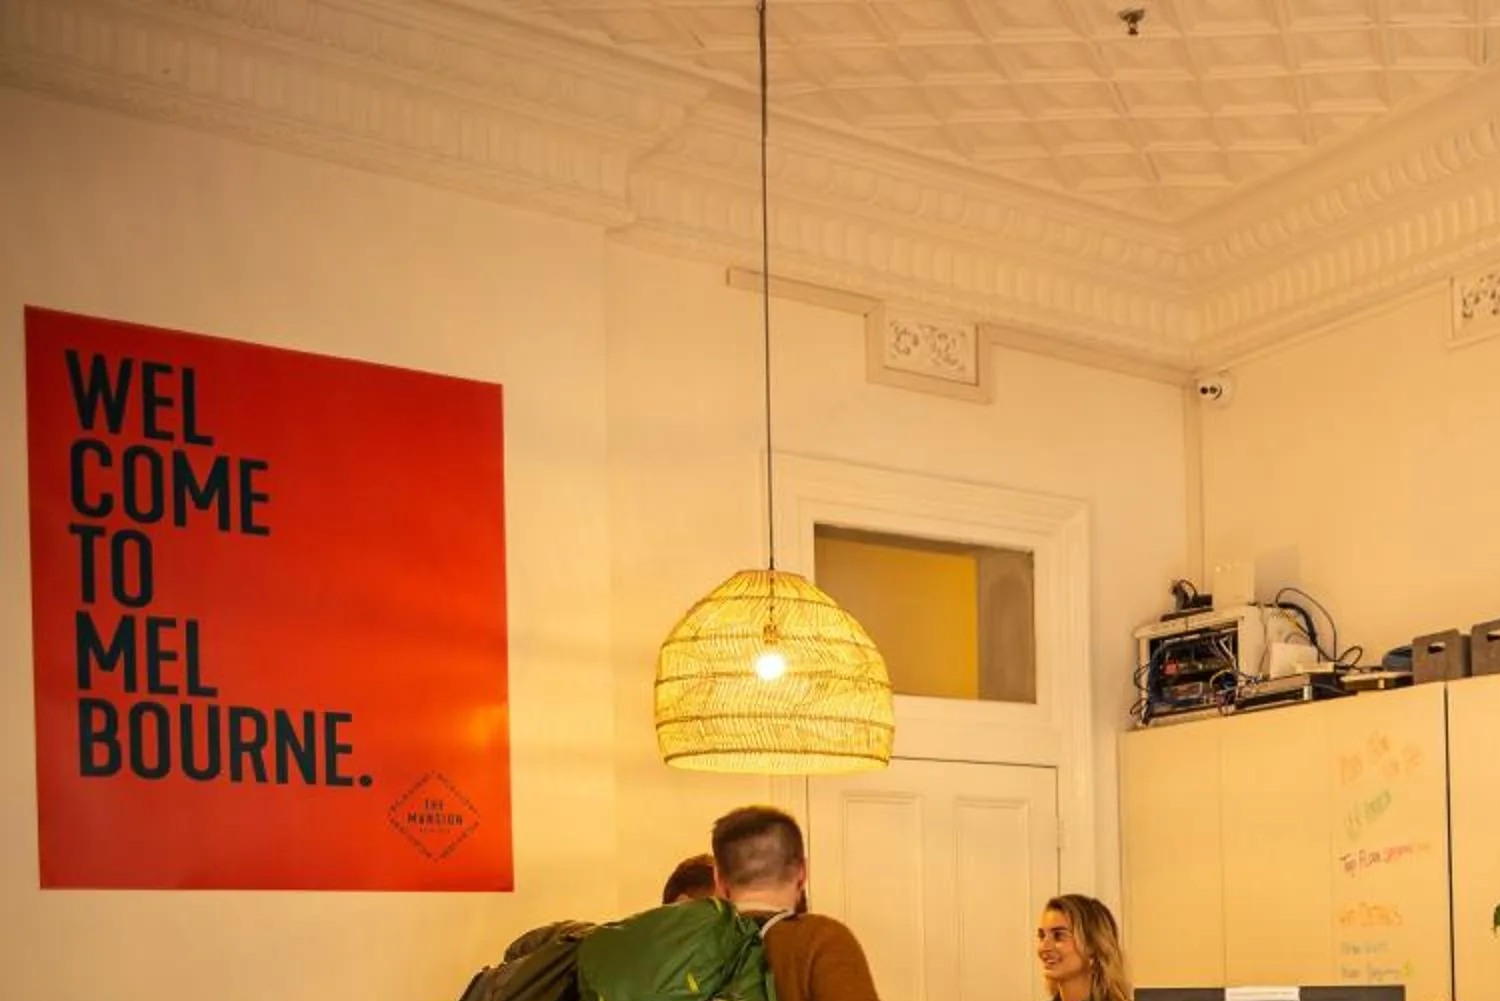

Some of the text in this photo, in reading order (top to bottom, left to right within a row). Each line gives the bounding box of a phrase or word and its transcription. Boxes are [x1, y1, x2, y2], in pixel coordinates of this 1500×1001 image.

[64, 347, 214, 447] WEL
[69, 438, 270, 537] COME
[68, 521, 154, 609] TO
[75, 610, 218, 698] MEL
[78, 697, 373, 788] BOURNE.
